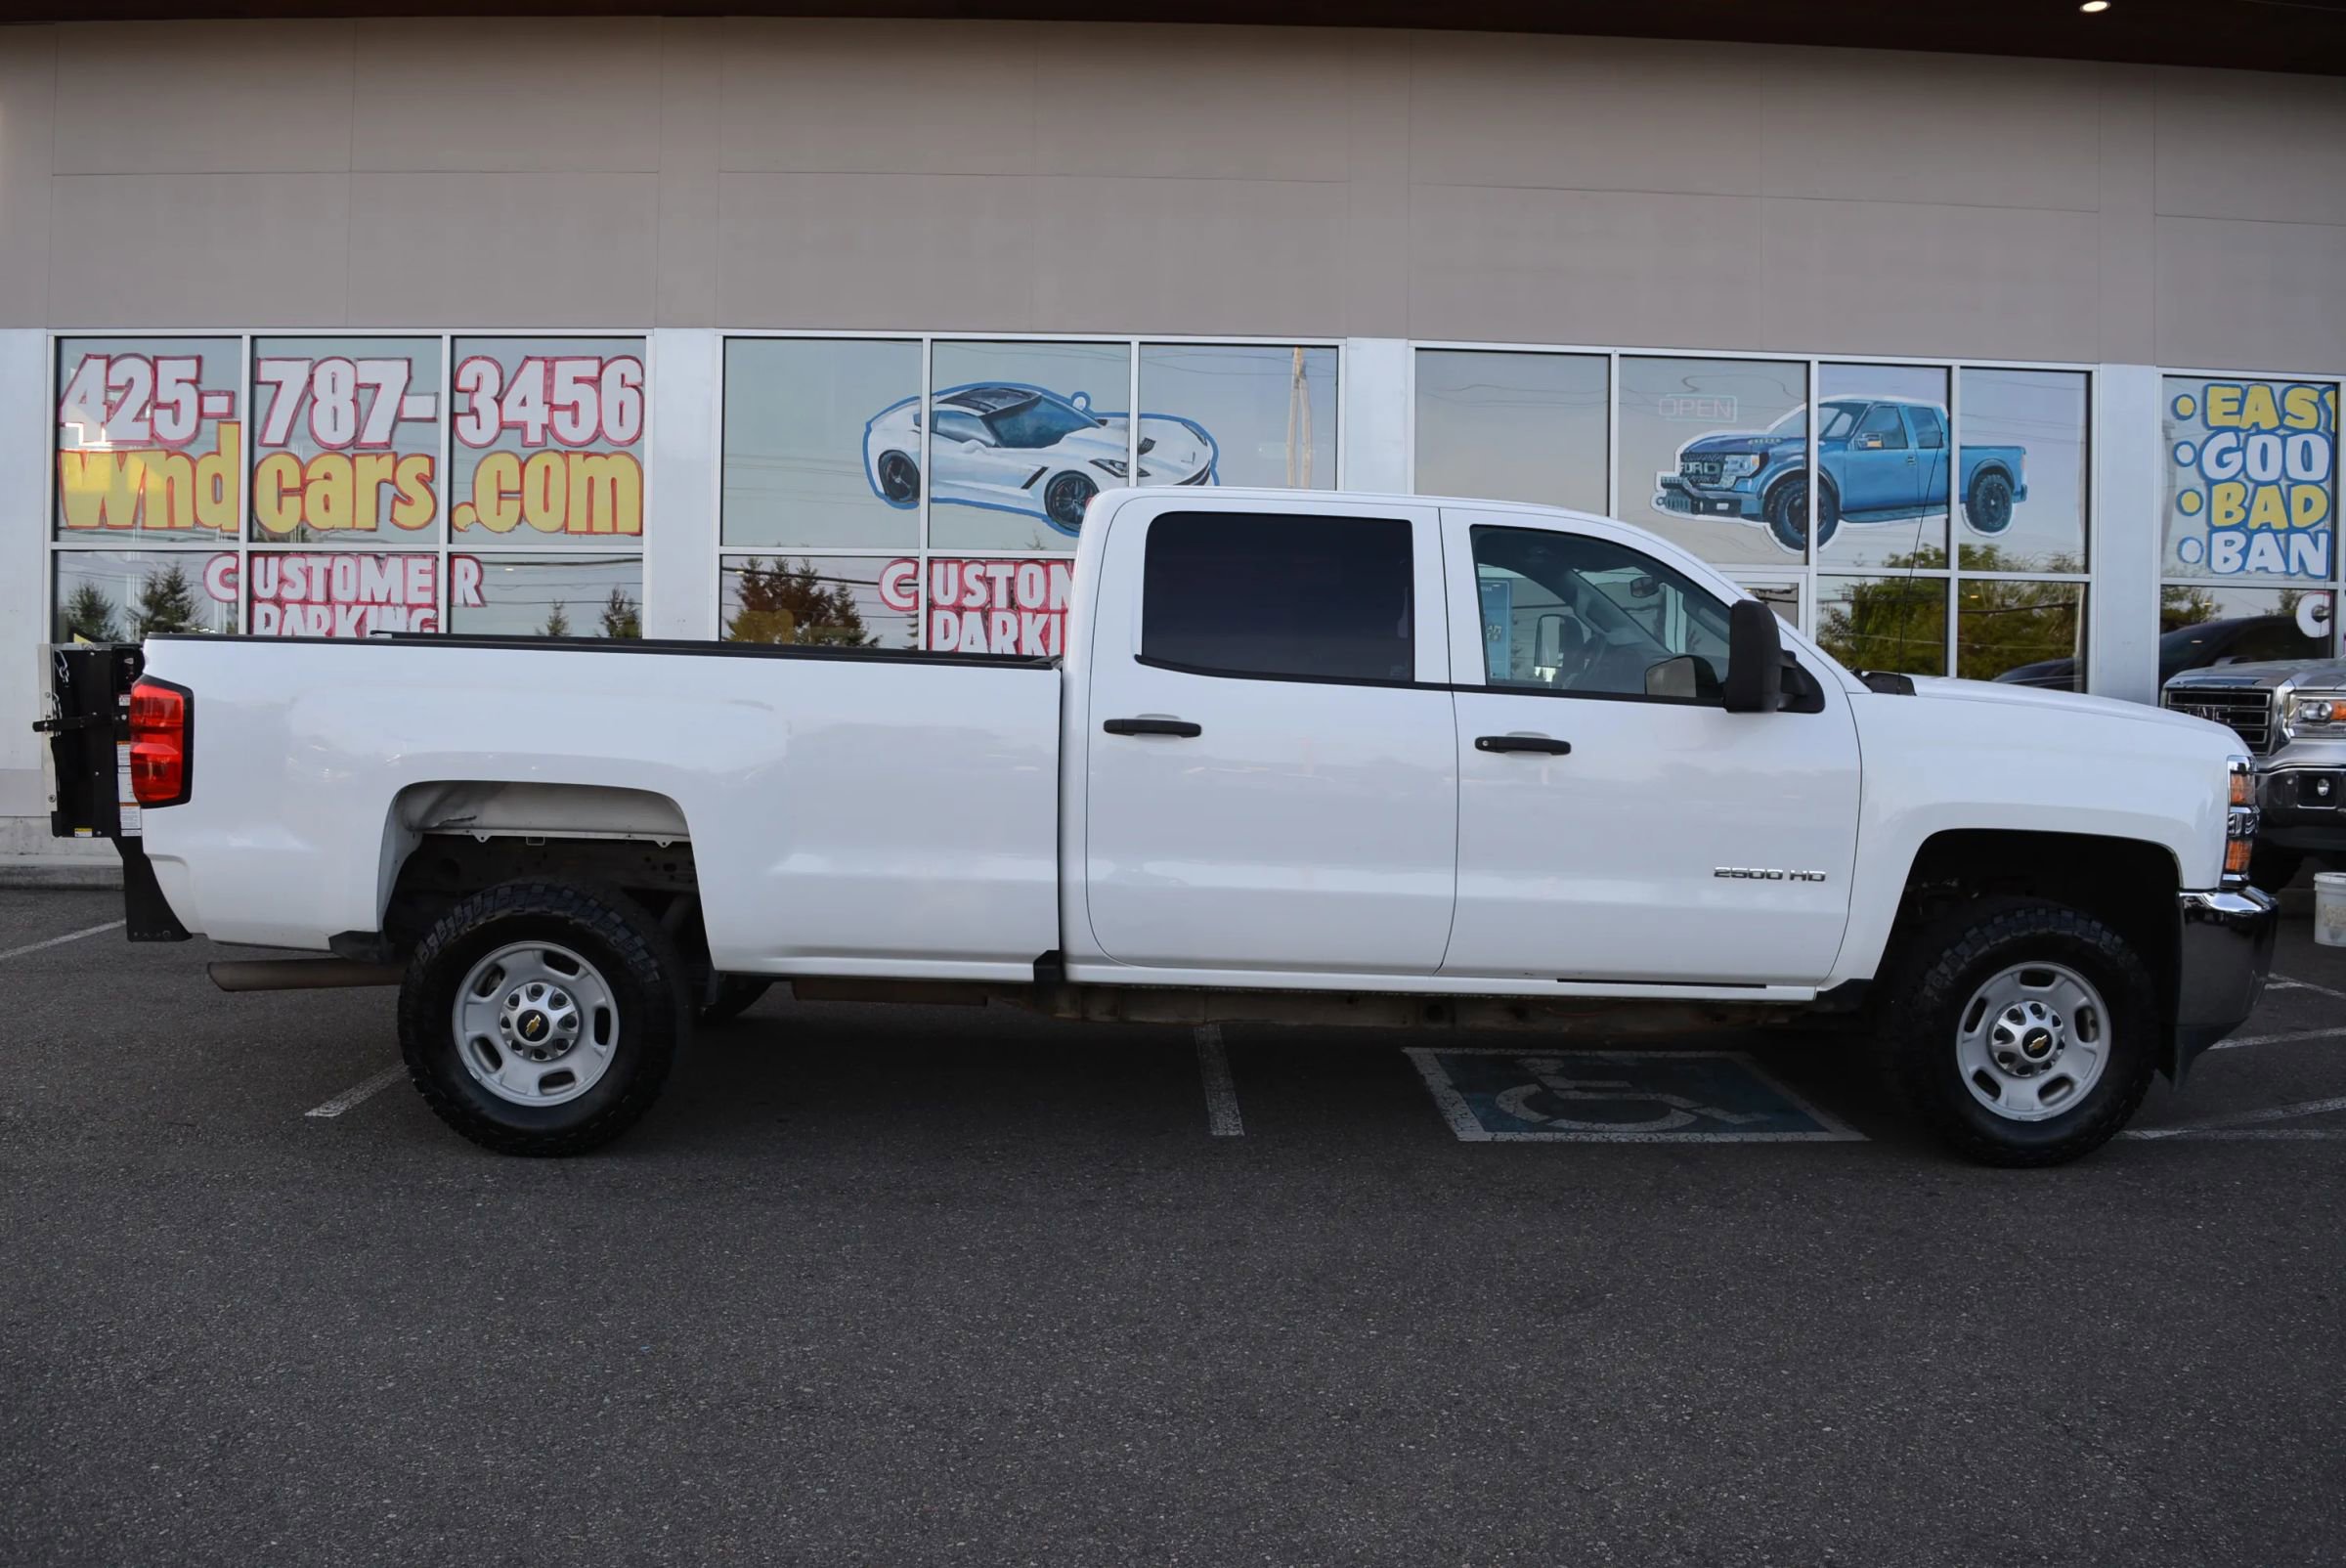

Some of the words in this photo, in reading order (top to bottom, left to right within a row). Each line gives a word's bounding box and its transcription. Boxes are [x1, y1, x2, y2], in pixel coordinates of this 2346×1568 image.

[1659, 398, 1731, 417] OPEN
[2206, 480, 2329, 530] BAD
[1714, 866, 1784, 881] 2500
[1789, 870, 1826, 882] HD
